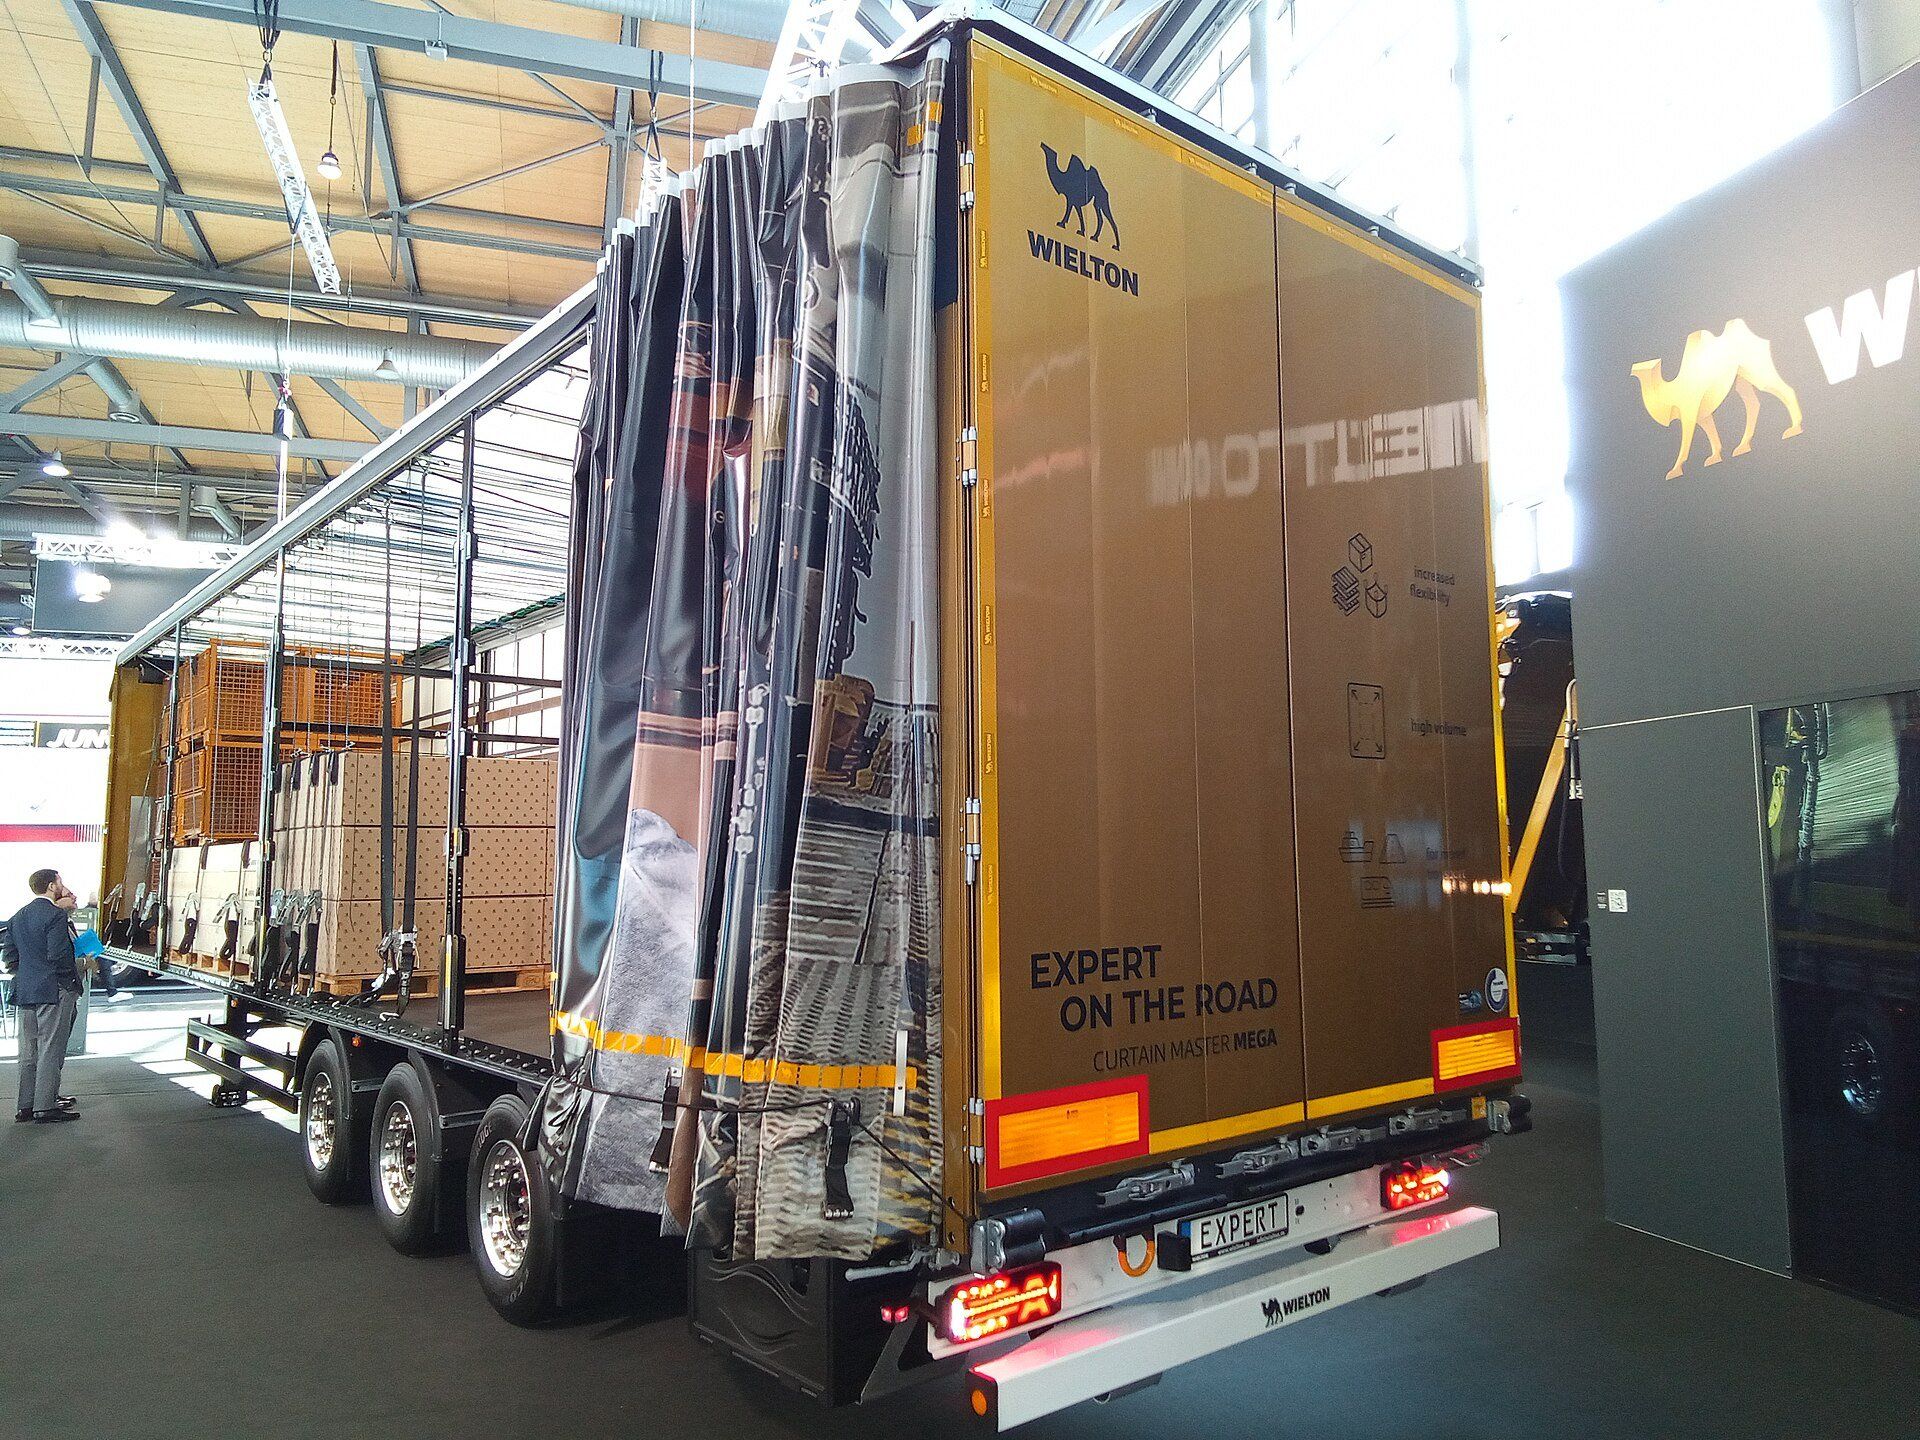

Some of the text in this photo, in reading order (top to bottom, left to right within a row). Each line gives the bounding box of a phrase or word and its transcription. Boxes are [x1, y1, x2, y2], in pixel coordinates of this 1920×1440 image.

[1027, 229, 1138, 297] WIELTON
[1804, 265, 1920, 385] W
[1413, 565, 1455, 586] increased
[46, 728, 109, 748] JUN
[1411, 718, 1467, 737] high volume
[1031, 945, 1161, 989] EXPERT
[1060, 977, 1278, 1032] ON THE ROAD
[1093, 1028, 1277, 1072] CURTAIN MASTER MEGA
[1201, 1202, 1278, 1249] EXPERT
[1283, 1287, 1331, 1315] WIELTON
